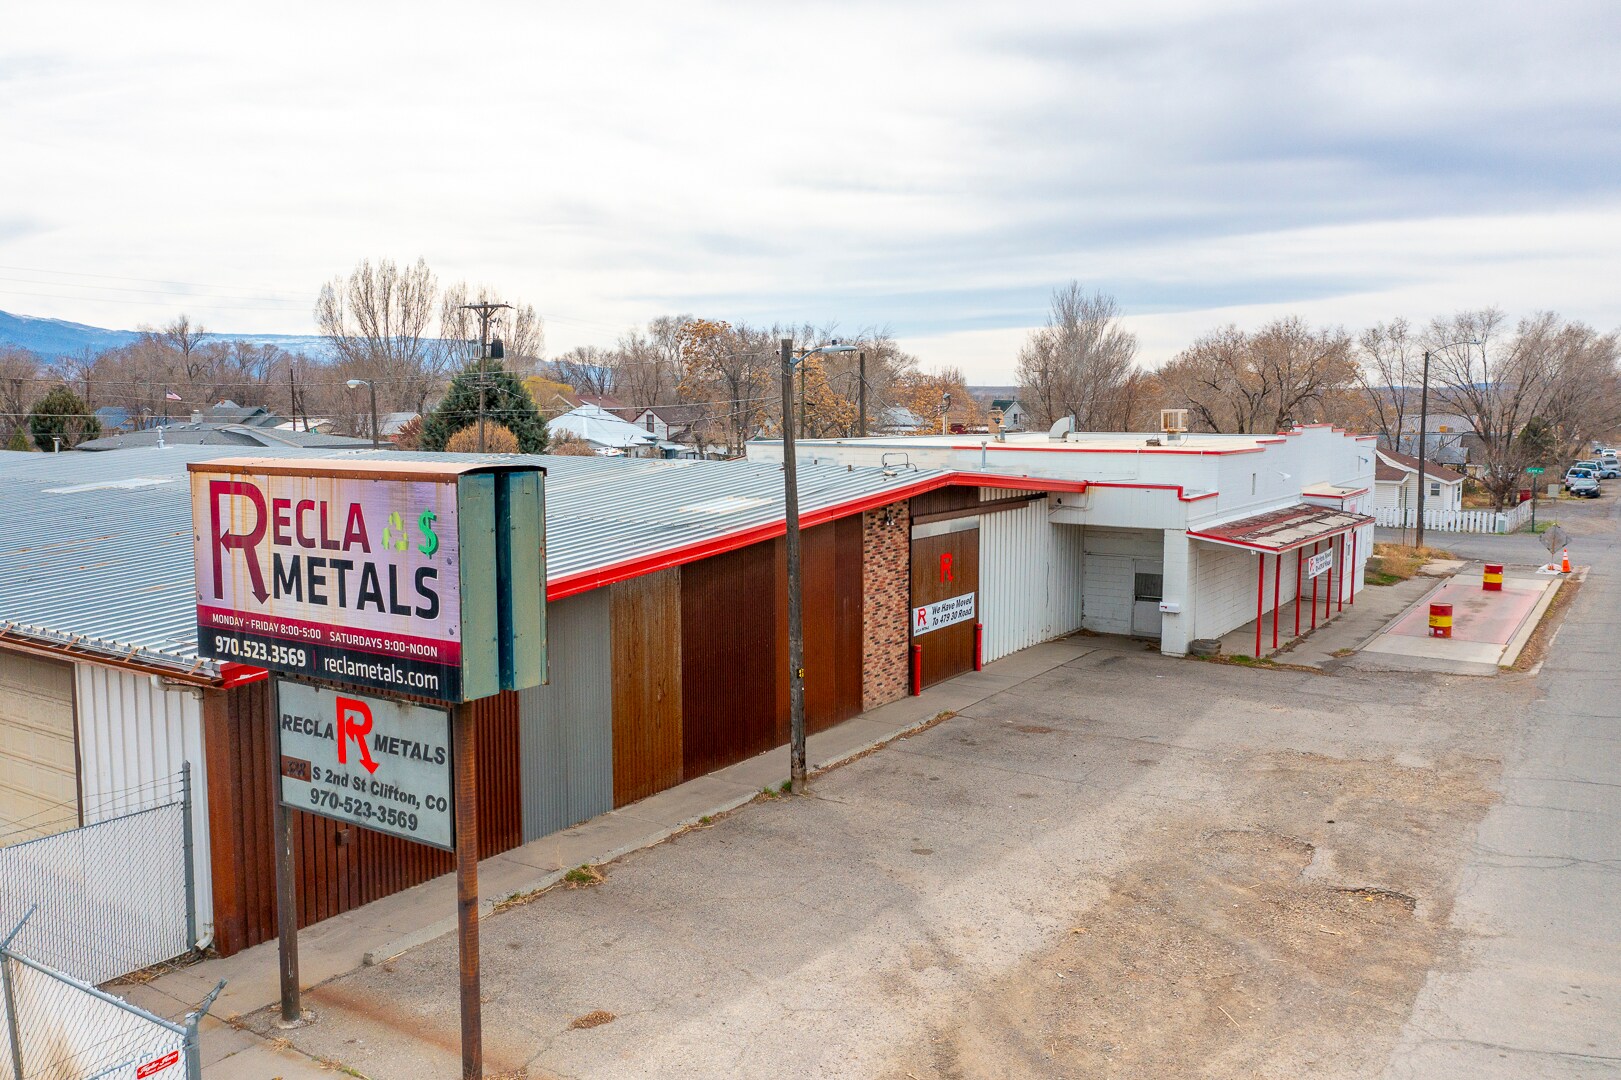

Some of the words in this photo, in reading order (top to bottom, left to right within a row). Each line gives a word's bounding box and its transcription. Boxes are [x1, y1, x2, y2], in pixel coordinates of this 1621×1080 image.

[209, 480, 371, 604] RECLA
[273, 553, 440, 620] METALS
[932, 606, 940, 615] We
[941, 602, 955, 612] Have
[956, 596, 972, 608] Moved
[212, 615, 244, 627] MONDAY
[251, 619, 279, 633] FRIDAY
[281, 623, 321, 640] 8:00-5:00
[330, 631, 382, 649] SATURDAYS
[385, 640, 438, 658] 9:00-NOON
[932, 617, 939, 626] To
[940, 614, 950, 623] 479
[950, 611, 958, 620] 30
[959, 607, 972, 618] Road
[215, 636, 306, 667] 970.523.3569
[324, 656, 439, 690] reclametals.com
[282, 714, 335, 741] RECLA
[374, 734, 446, 765] METALS
[310, 788, 418, 831] 970-523-3569
[312, 766, 321, 780] S
[325, 769, 349, 787] 2nd
[353, 776, 366, 792] St
[370, 780, 421, 810] Clifton,
[425, 795, 447, 812] CO
